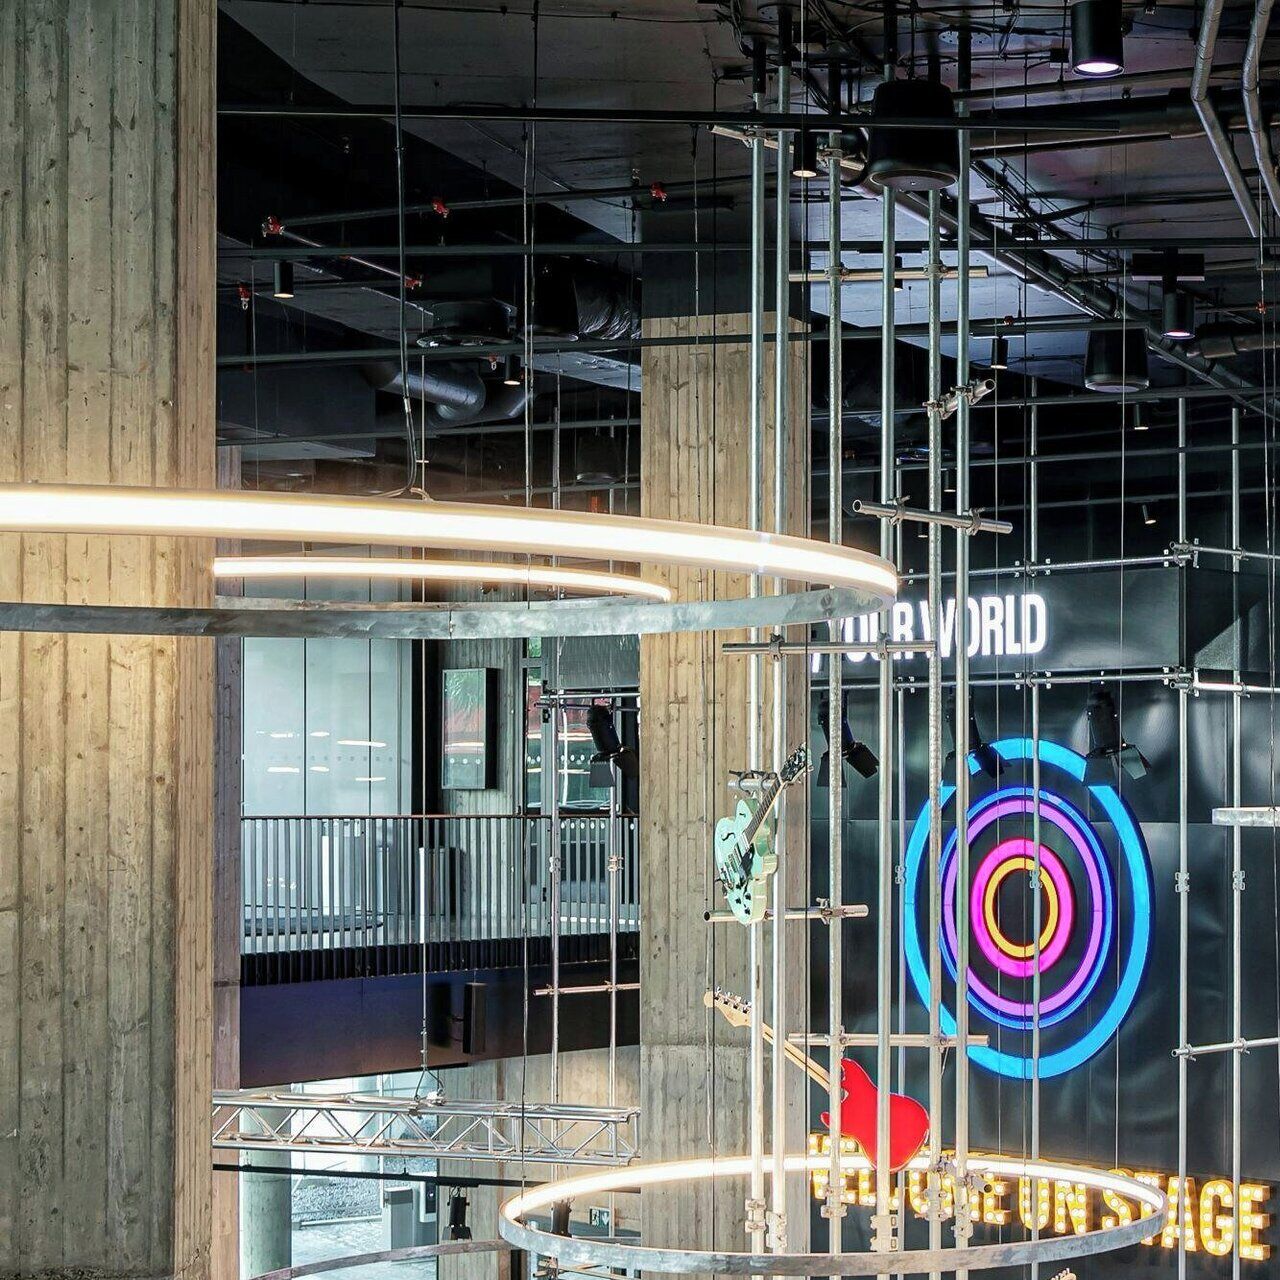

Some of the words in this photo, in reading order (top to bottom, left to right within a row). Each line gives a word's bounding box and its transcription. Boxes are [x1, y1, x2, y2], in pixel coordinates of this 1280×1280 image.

[828, 602, 914, 662] OR
[919, 593, 1046, 658] WORLD
[808, 1133, 1010, 1226] WELOME
[1018, 1160, 1093, 1235] ON
[1101, 1168, 1270, 1260] STAGE
